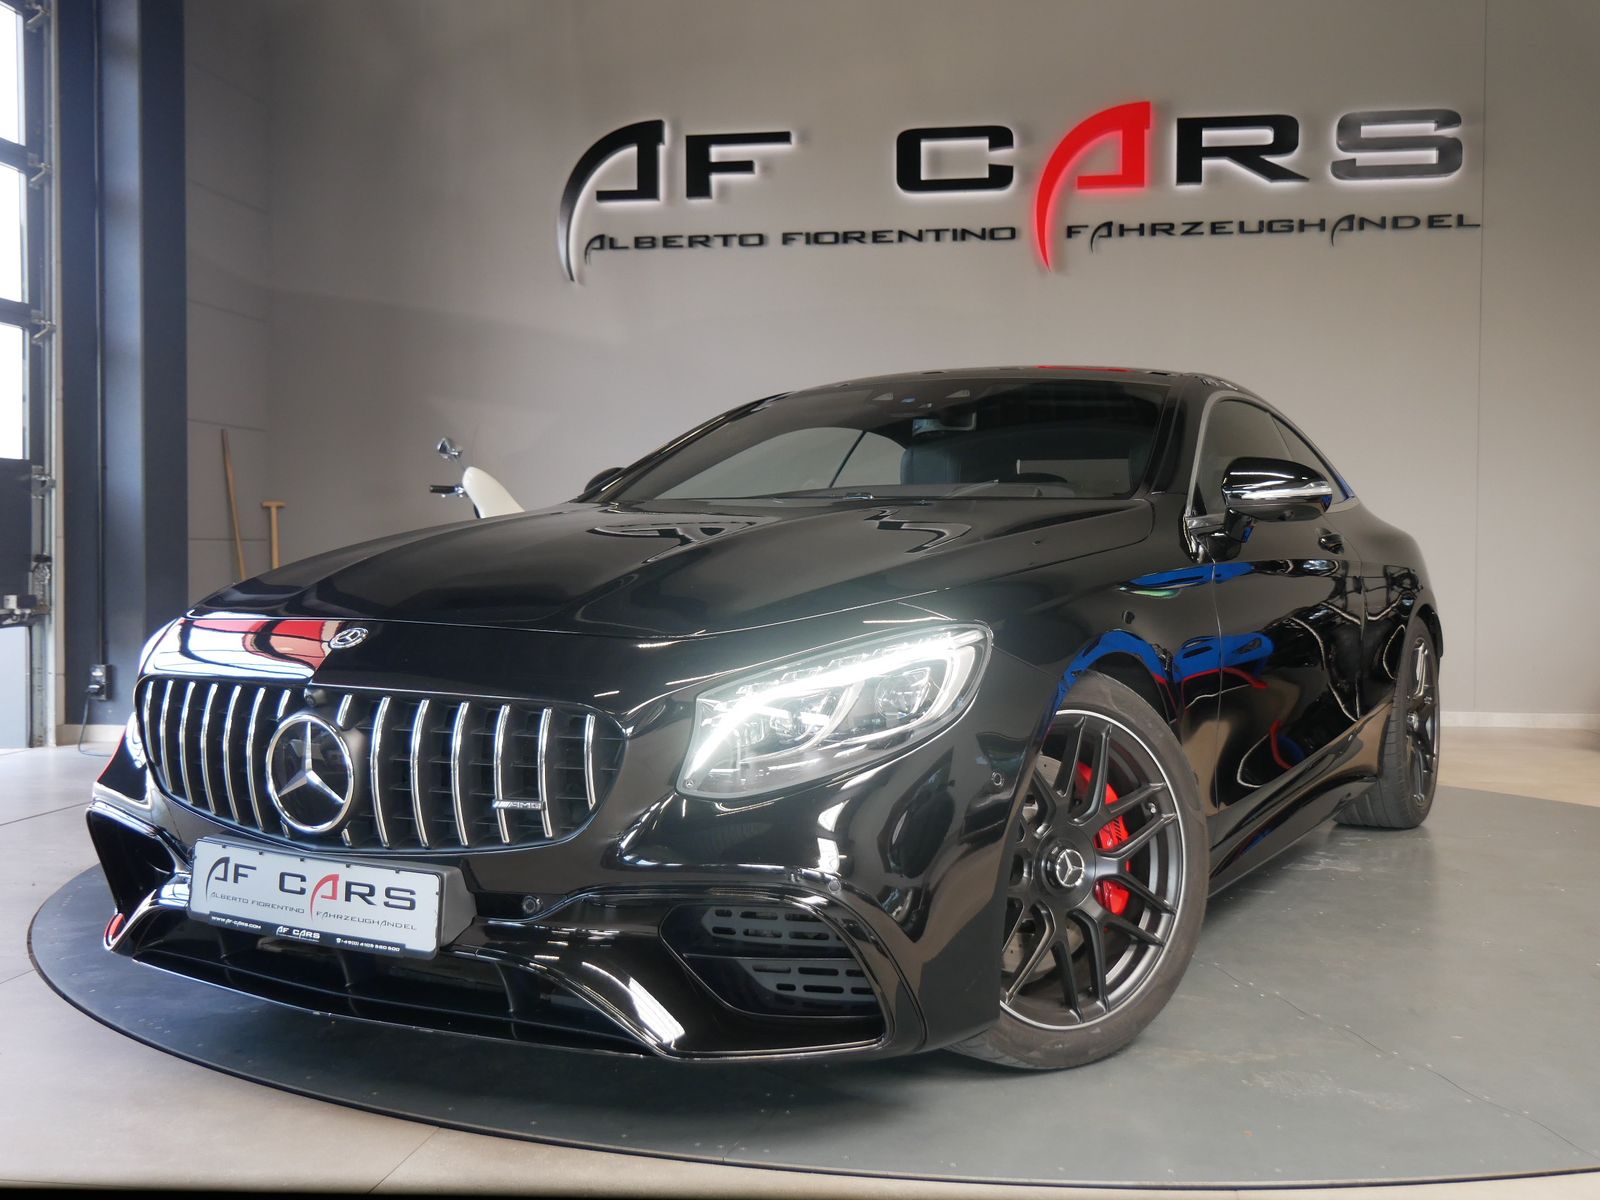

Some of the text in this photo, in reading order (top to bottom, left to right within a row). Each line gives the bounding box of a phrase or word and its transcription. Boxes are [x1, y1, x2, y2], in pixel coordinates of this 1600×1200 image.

[558, 101, 1463, 282] AF CARS
[584, 213, 1481, 264] ALBERTO FIORENTINO FAHRZEUGHANDEL
[206, 856, 416, 922] AF CARS
[211, 892, 417, 931] ALBERTO FIORENTINO FAHRZEUGHANDEL
[276, 925, 290, 935] AF
[292, 928, 320, 940] CARS
